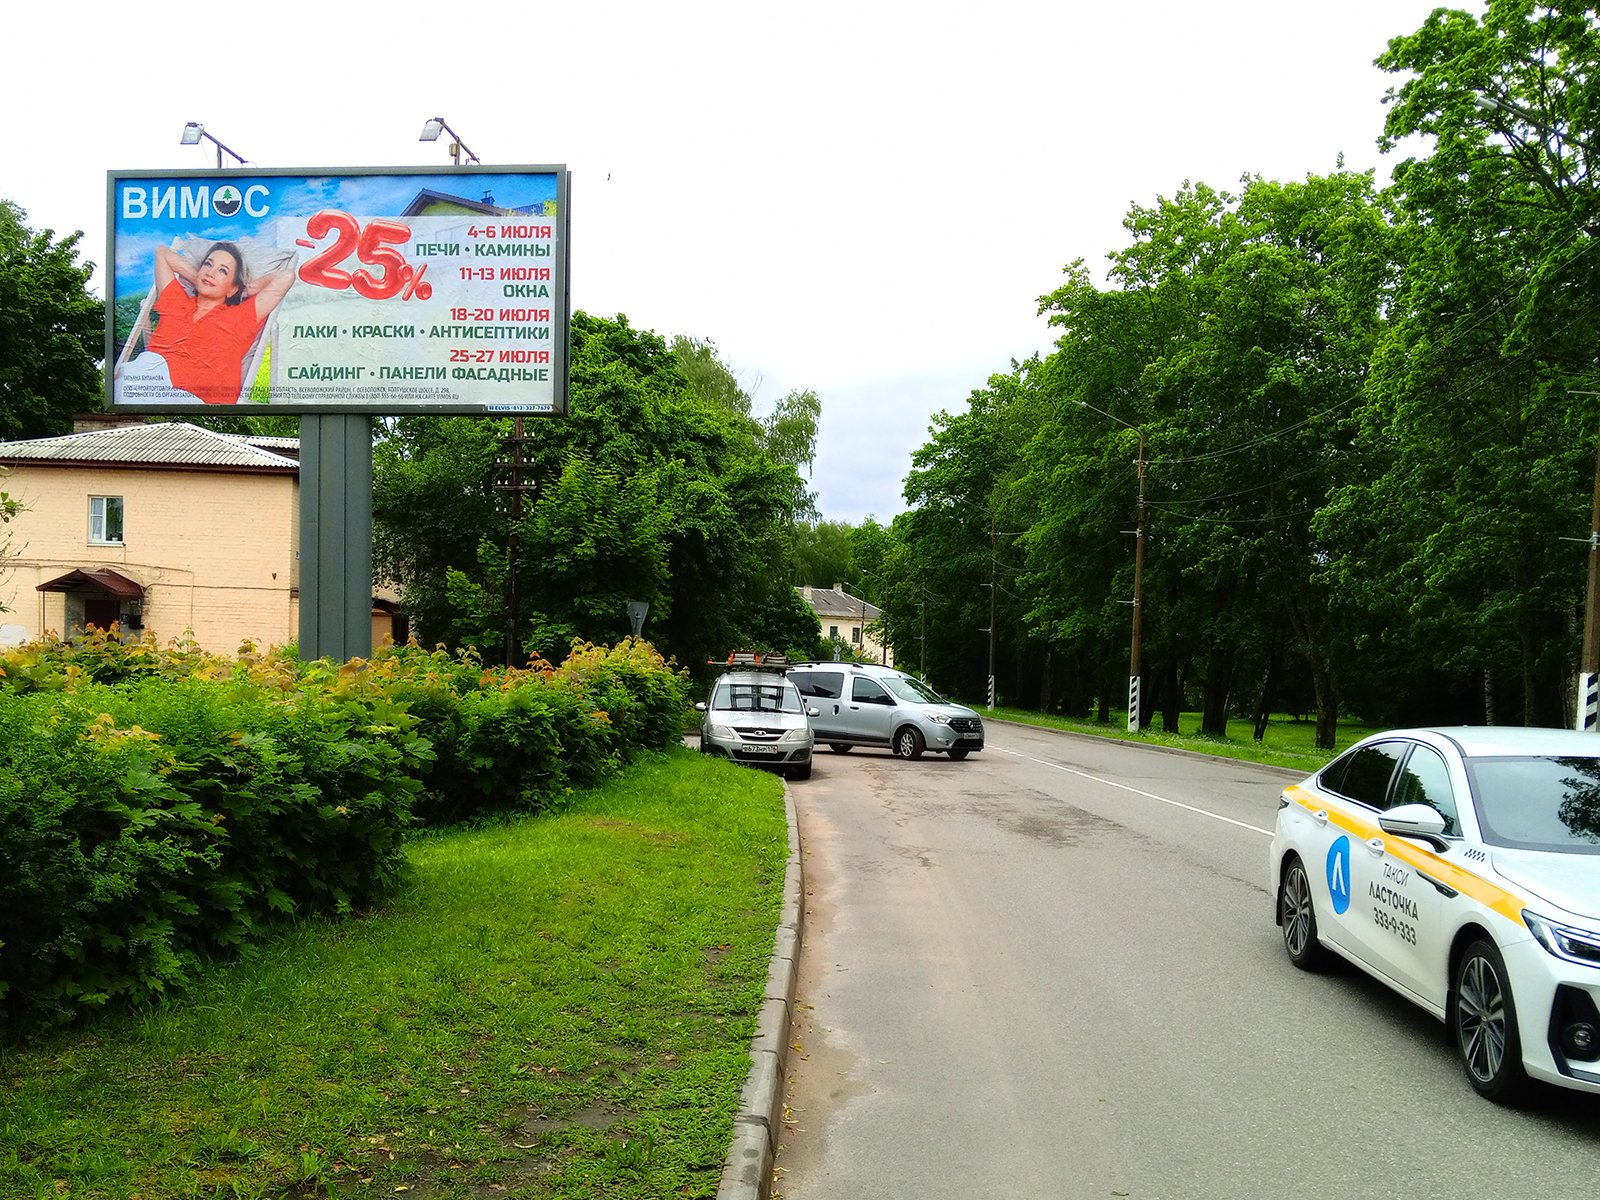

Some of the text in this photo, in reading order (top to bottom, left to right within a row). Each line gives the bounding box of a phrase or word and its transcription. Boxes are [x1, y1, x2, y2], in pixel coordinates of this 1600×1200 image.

[122, 184, 270, 219] ВИМОС
[467, 225, 552, 239] 4-6 ИЮЛЯ
[295, 209, 433, 301] -25%
[416, 243, 551, 257] ПЕЧИ КАМИНЫ
[459, 267, 551, 281] 11-13 ИЮЛЯ
[503, 284, 549, 298] ОКНА
[450, 308, 550, 322] 18-20 ИЮЛЯ
[292, 325, 549, 340] ЛАКИ КРАСКИ АНТИСЕПТИКИ
[449, 349, 549, 364] 25-27 ИЮЛЯ
[287, 363, 548, 382] САЙДИНГ ПАНЕЛИ ФАСАДНЫЕ
[1383, 862, 1409, 886] ТАКСИ
[1369, 881, 1419, 921] ЛАСТОЧКА
[1373, 907, 1417, 946] 333-9-333
